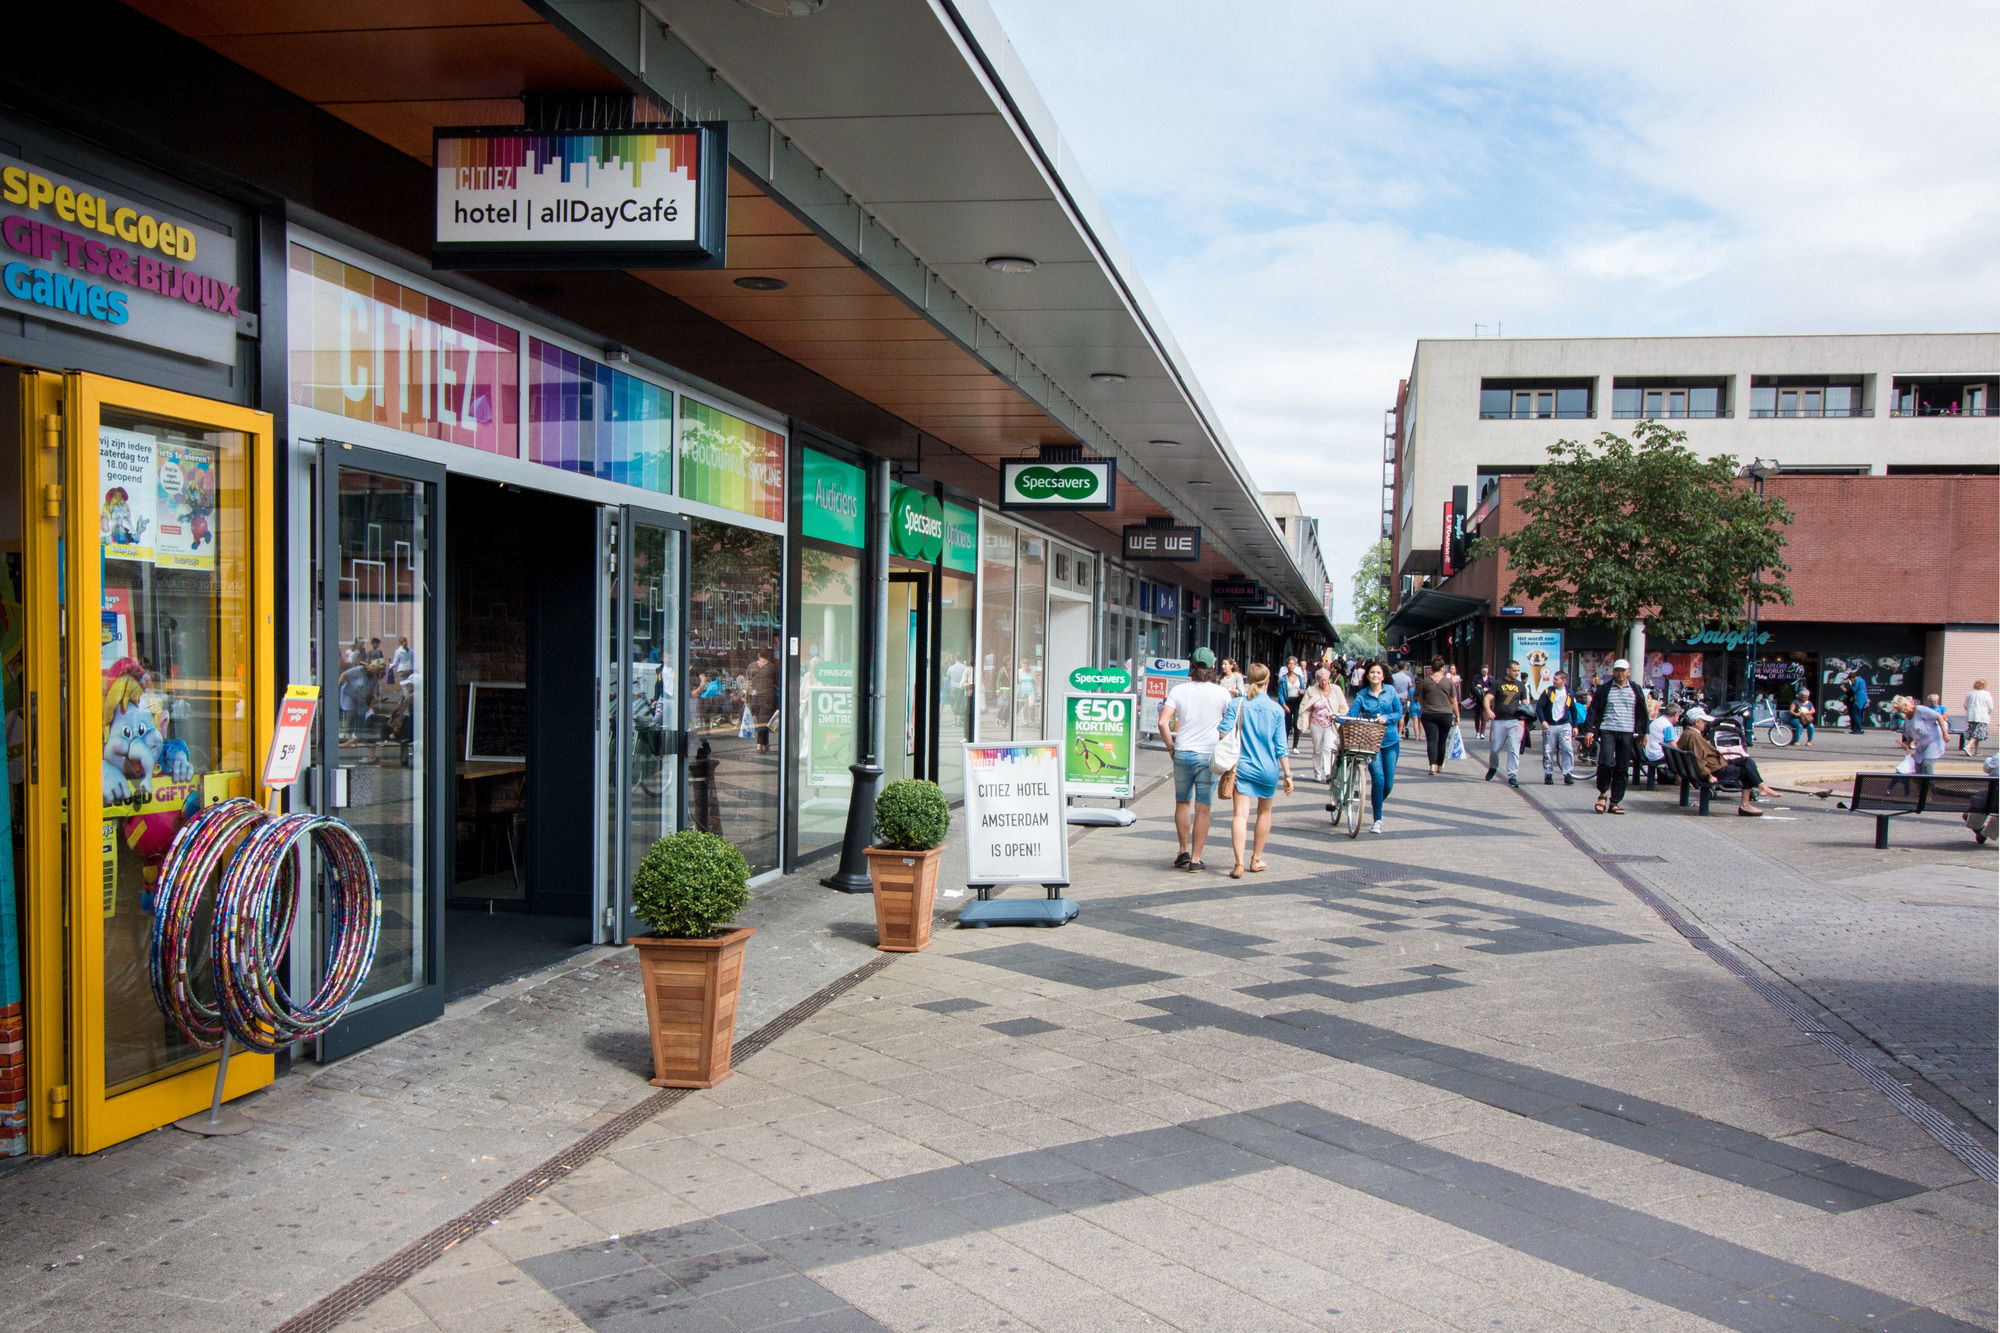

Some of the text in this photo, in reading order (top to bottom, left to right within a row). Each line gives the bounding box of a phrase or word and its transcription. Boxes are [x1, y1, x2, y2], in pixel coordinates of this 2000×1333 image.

[458, 166, 514, 189] CITIEZ
[454, 200, 517, 223] hotel
[540, 199, 678, 229] allDayCafé
[340, 291, 478, 432] CITIEZ
[112, 438, 126, 450] zijn
[128, 441, 152, 453] iedere
[100, 448, 150, 463] zaterdag tot
[107, 459, 143, 473] 18.00 uur
[107, 472, 143, 483] geopend
[748, 460, 782, 488] SKYLINE
[1022, 475, 1091, 490] Specsavers
[814, 478, 857, 518] Audiciens
[904, 504, 942, 538] Specsavers
[1129, 536, 1192, 550] WE WE
[1155, 659, 1182, 669] etos
[1075, 673, 1125, 684] Specsavers
[1149, 681, 1164, 691] 1+1
[1075, 699, 1125, 722] €50
[1076, 721, 1124, 733] KORTING
[978, 782, 1050, 798] CITIEZ HOTEL
[981, 813, 1049, 828] AMSTERDAM
[991, 843, 1041, 857] IS OPEN!!
